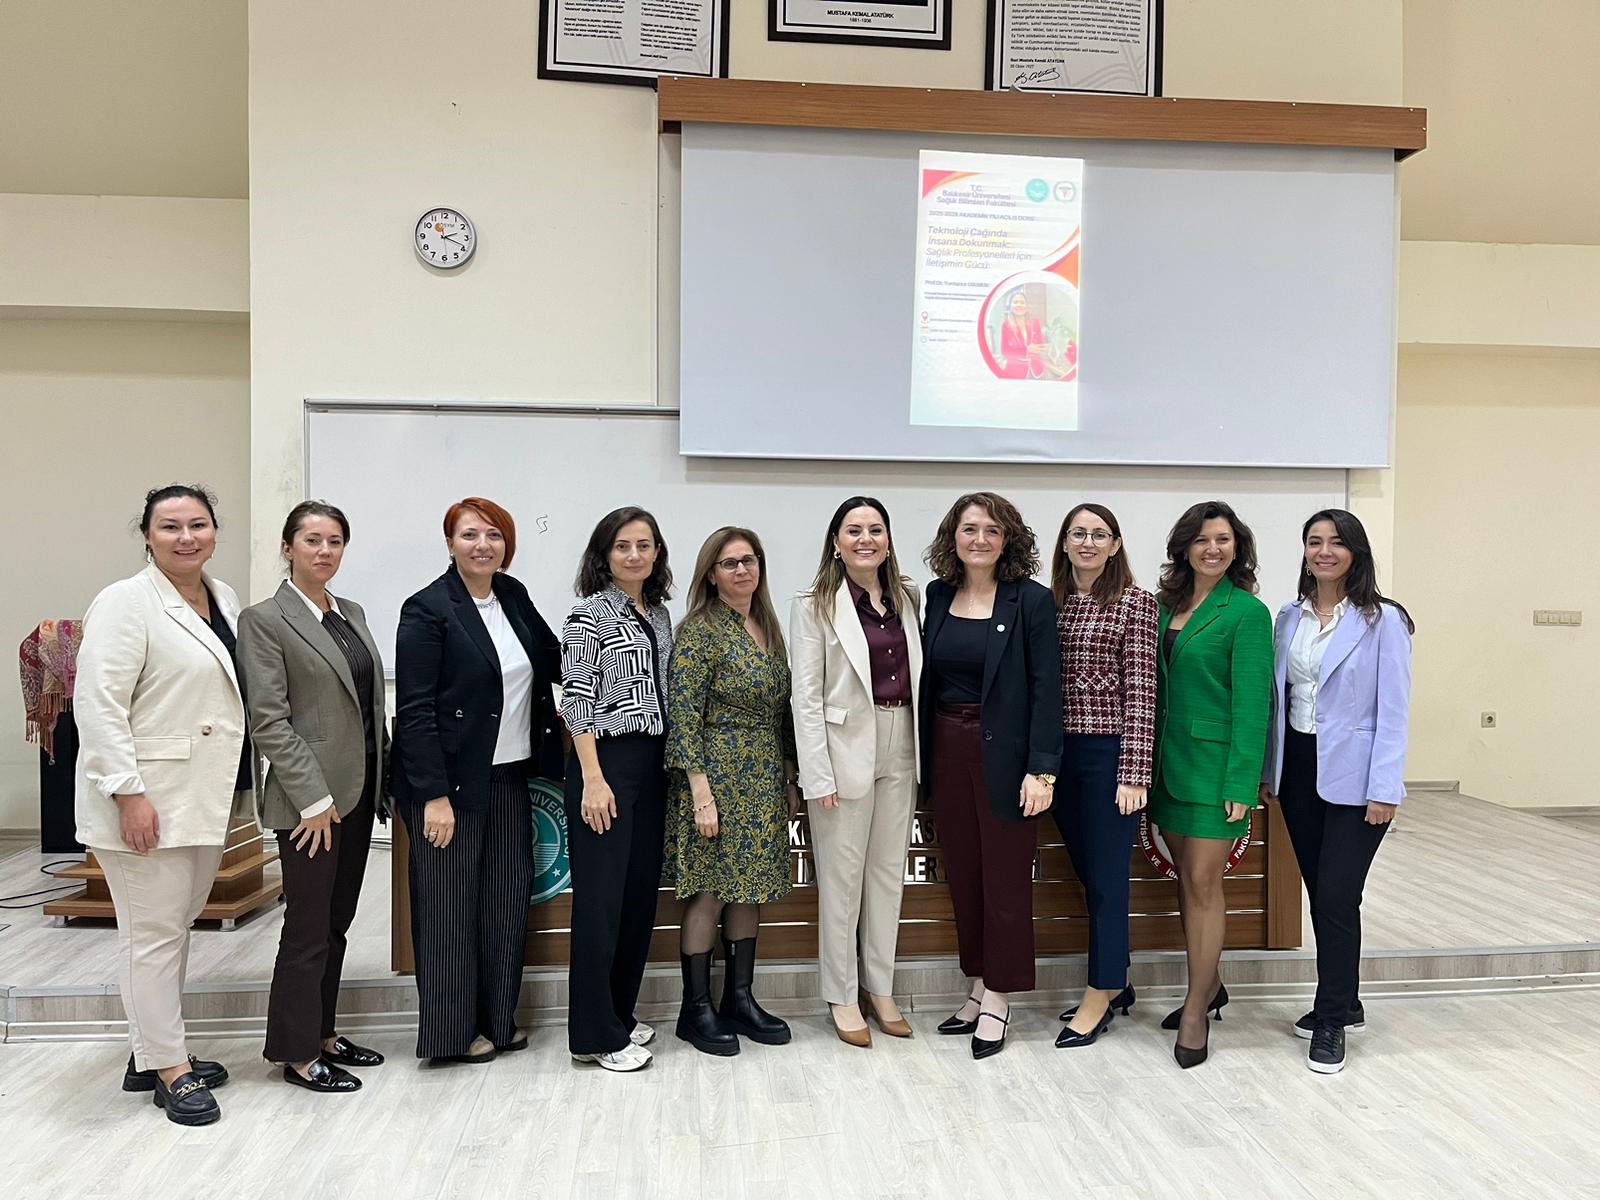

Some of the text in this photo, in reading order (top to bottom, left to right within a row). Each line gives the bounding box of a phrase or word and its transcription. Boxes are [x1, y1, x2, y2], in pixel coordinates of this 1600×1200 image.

[928, 226, 1008, 239] Teknoloji Çağında
[928, 236, 957, 246] İnsana
[926, 248, 952, 258] Sağlık
[953, 249, 1016, 261] Profesyonelleri
[1151, 855, 1162, 867] VE
